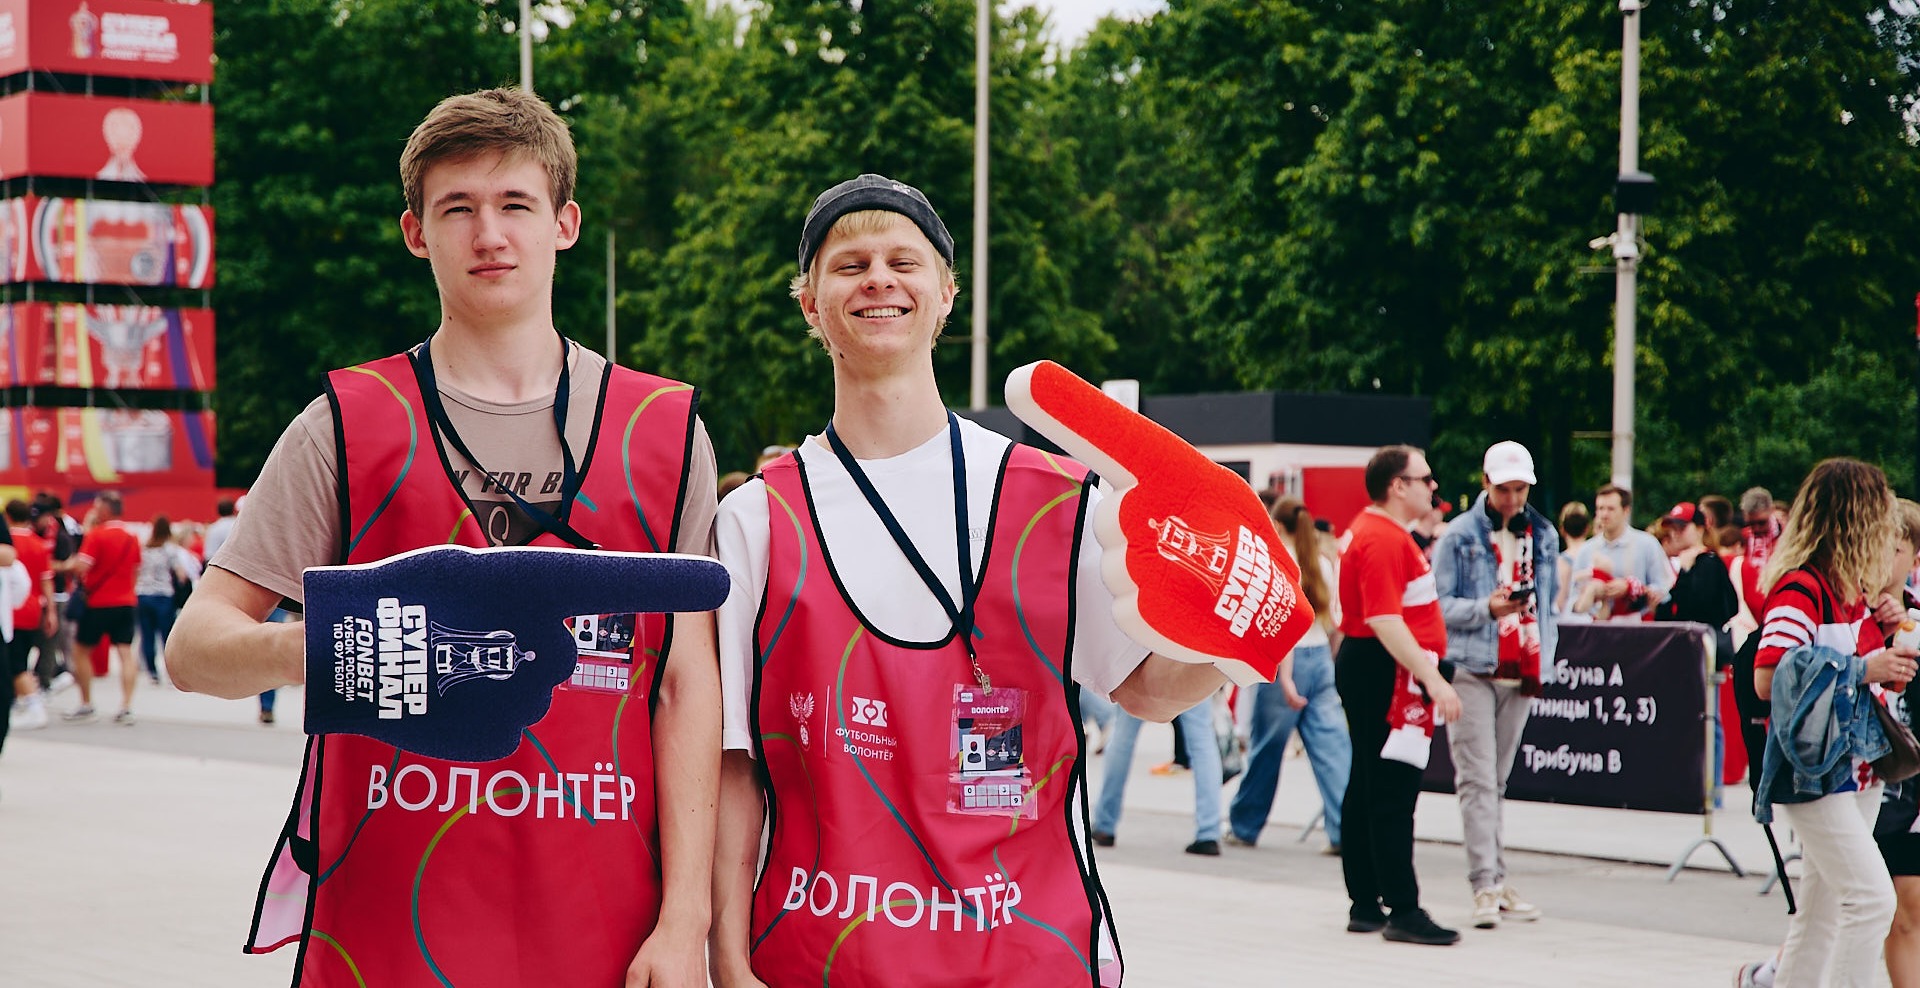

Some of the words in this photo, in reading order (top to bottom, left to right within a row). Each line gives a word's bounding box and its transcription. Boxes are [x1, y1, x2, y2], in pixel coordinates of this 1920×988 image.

[480, 471, 532, 495] FOR
[540, 471, 563, 494] B
[1214, 524, 1256, 621] СУПЕР
[1228, 535, 1272, 639] ФИНАЛ
[333, 623, 344, 639] ПО
[343, 615, 355, 655] КУБОК
[1261, 605, 1285, 638] КУБОК
[1269, 622, 1282, 638] ПО
[334, 640, 345, 695] ФУТБОЛУ
[355, 617, 374, 703] FONBET
[376, 597, 403, 720] ФИНАЛ
[402, 604, 428, 715] СУПЕР
[1554, 658, 1605, 691] буна
[345, 656, 355, 702] РОССИИ
[1530, 696, 1590, 722] тницы
[1593, 695, 1609, 725] 1,
[1613, 696, 1633, 726] 2,
[1636, 695, 1657, 725] 3)
[835, 727, 898, 748] ФУТБОЛЬНЫЙ
[843, 743, 894, 761] ВОЛОНТЁР
[1521, 743, 1604, 776] Трибуна
[367, 762, 636, 821] ВОЛОНТЁР
[782, 866, 1022, 932] ВОЛОНТЁР
